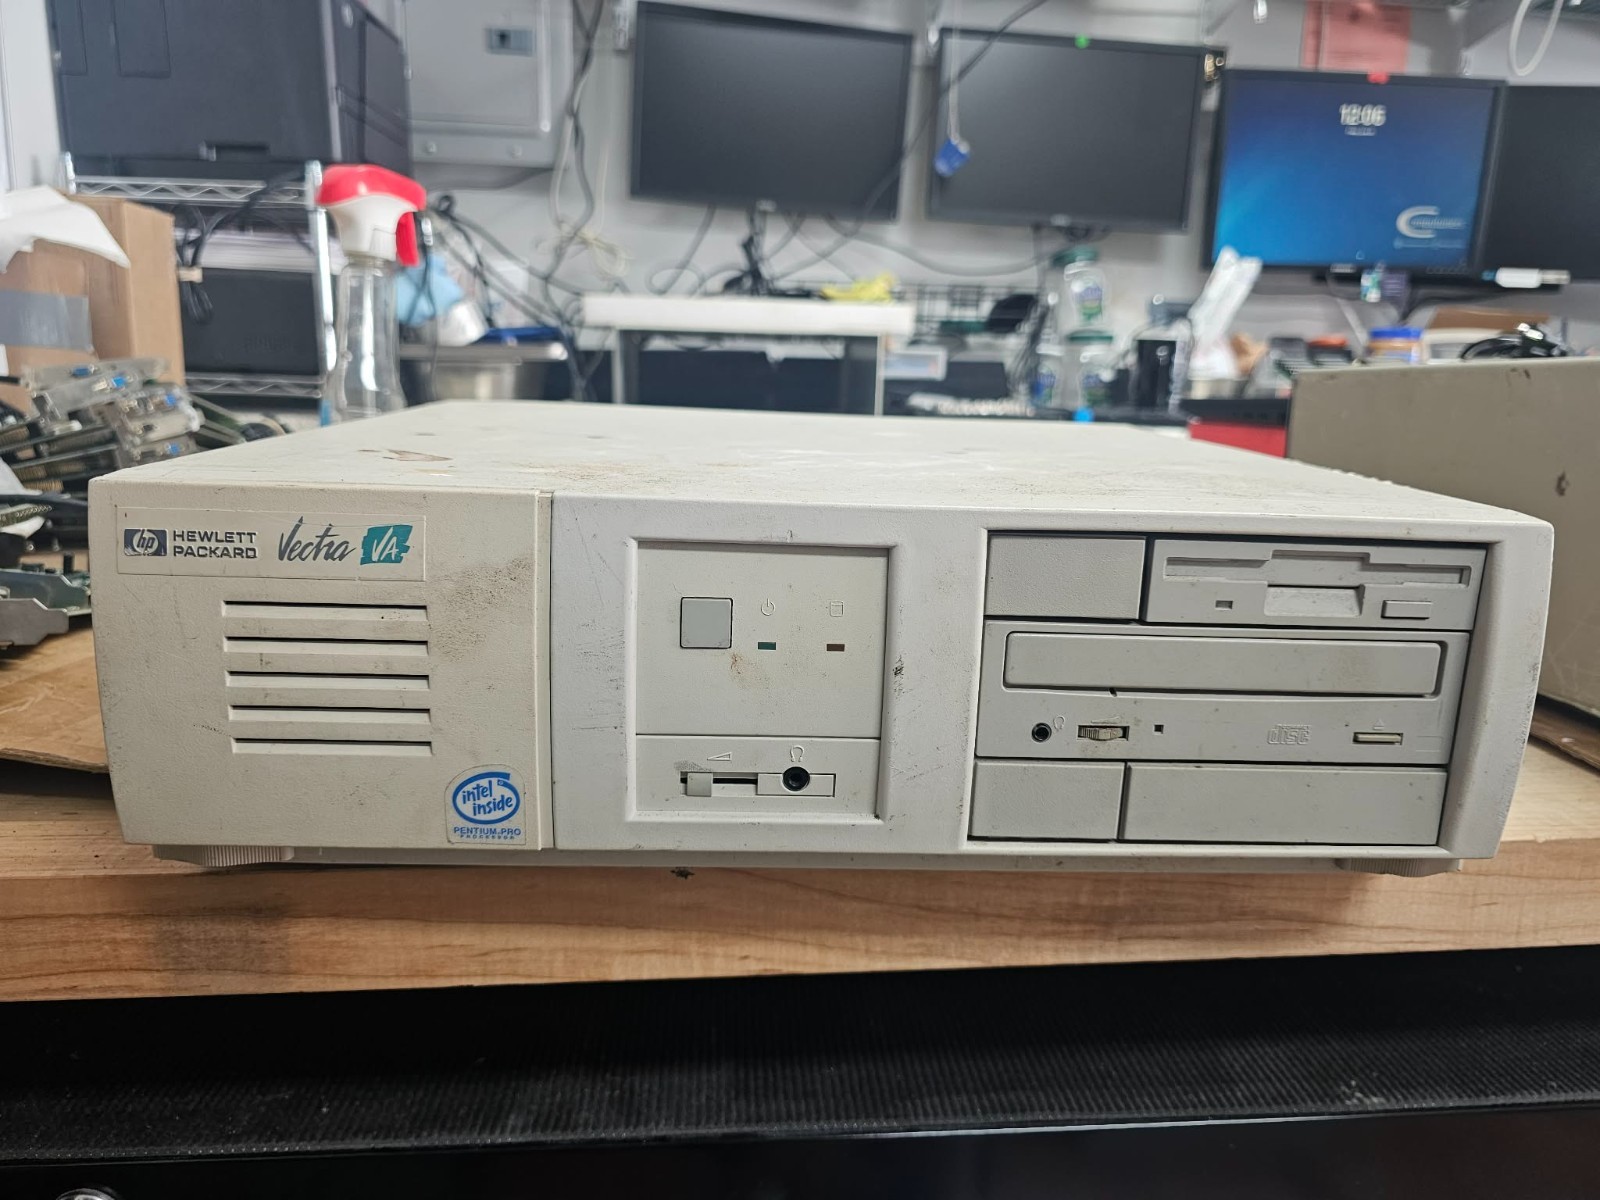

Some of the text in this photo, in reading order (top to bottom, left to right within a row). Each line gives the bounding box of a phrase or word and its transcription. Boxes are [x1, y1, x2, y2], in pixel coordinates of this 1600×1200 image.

[173, 530, 257, 544] HEWLETT
[278, 516, 357, 562] Vectra
[371, 527, 399, 560] VA
[173, 545, 258, 559] PACKARD
[462, 779, 493, 805] intel
[472, 794, 513, 817] inside
[501, 828, 521, 836] PRO
